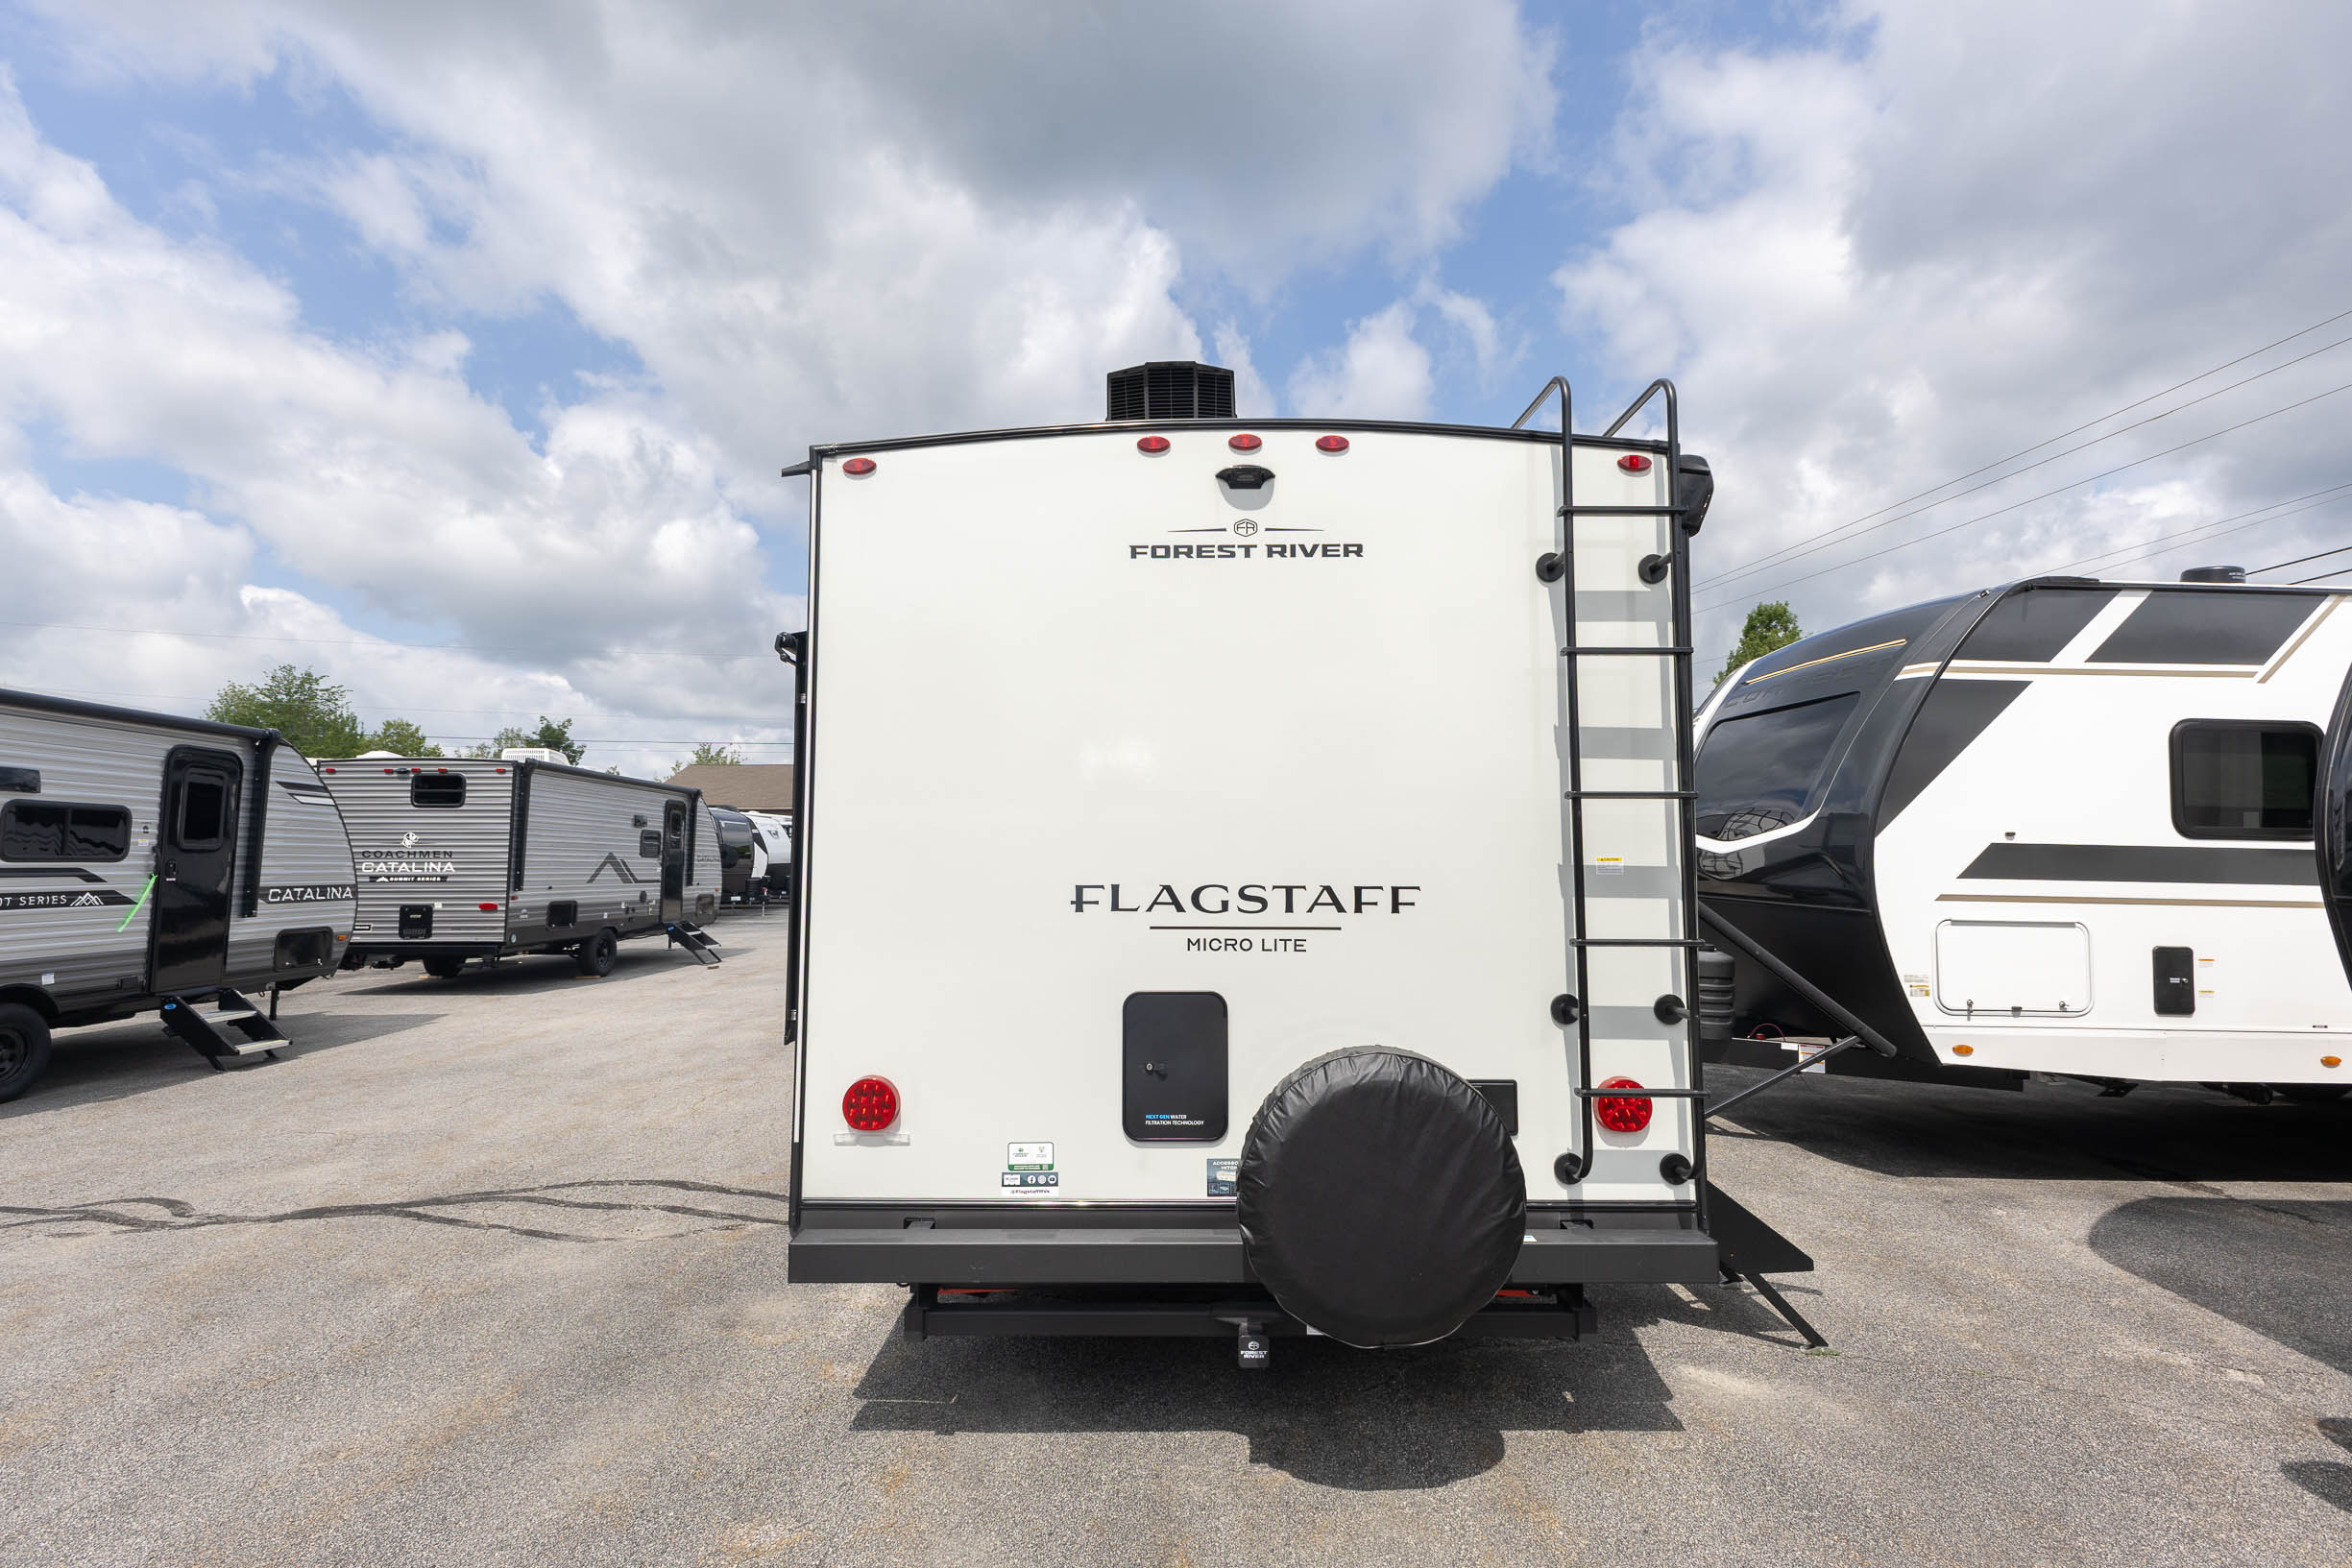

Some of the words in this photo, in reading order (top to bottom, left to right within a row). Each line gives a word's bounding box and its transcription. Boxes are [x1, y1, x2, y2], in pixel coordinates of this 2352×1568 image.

[1129, 544, 1257, 559] FOREST
[1265, 543, 1364, 558] RIVER
[361, 850, 453, 858] COACHMEN
[361, 861, 455, 873] CATALINA
[19, 895, 67, 905] SERIES
[269, 886, 352, 902] CATALINA
[1070, 883, 1421, 914] FLAGSTAFF
[1187, 938, 1253, 953] MICRO
[1261, 938, 1307, 953] LITE
